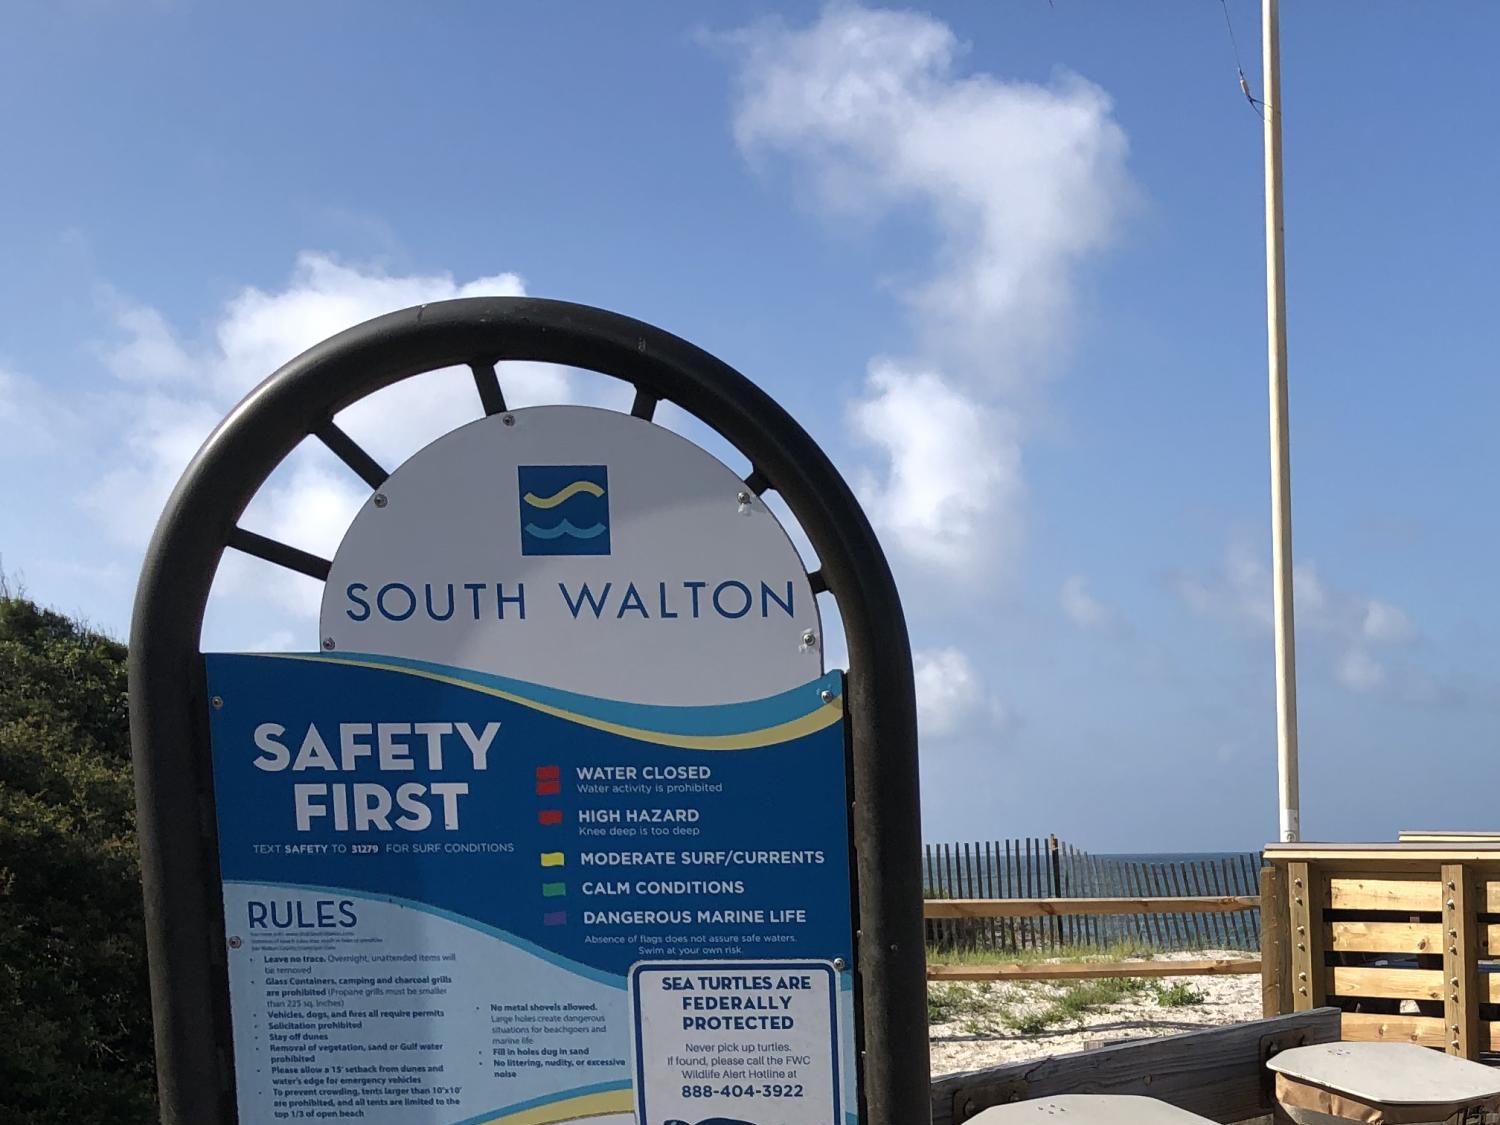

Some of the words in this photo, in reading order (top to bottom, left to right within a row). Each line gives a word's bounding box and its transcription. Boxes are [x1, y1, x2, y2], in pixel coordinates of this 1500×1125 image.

[347, 583, 525, 621] SOUTH
[558, 581, 794, 619] WALTON
[253, 722, 501, 771] SAFETY
[576, 767, 636, 780] WATER
[643, 766, 710, 779] CLOSED
[577, 784, 609, 793] Water
[612, 784, 651, 794] activity
[667, 783, 722, 793] prohibited
[294, 783, 468, 830] FIRST
[579, 810, 620, 822] HIGH
[626, 810, 699, 822] HAZARD
[579, 827, 606, 836] Knee
[610, 827, 636, 836] deep
[673, 826, 700, 836] deep
[253, 845, 280, 854] TEXT
[285, 844, 328, 854] SAFETY
[332, 844, 346, 853] TO
[352, 845, 378, 853] 31279
[386, 844, 408, 852] FOR
[413, 844, 440, 852] SURF
[444, 843, 514, 852] CONDITIONS
[581, 852, 675, 865] MODERATE
[682, 850, 824, 866] SURF/CURRENTS
[582, 882, 630, 894] CALM
[636, 881, 744, 894] CONDITIONS
[248, 900, 357, 928] RULES
[584, 911, 691, 924] DANGEROUS
[698, 910, 764, 923] MARINE
[770, 910, 806, 922] LIFE
[628, 935, 637, 943] of
[640, 935, 662, 944] flags
[742, 934, 760, 942] safe
[638, 946, 664, 954] Swim
[678, 945, 701, 955] your
[662, 977, 694, 990] SEA
[698, 976, 772, 990] TURTLES
[776, 976, 811, 990] ARE
[683, 996, 792, 1010] FEDERALLY
[318, 1021, 362, 1030] prohibited
[683, 1016, 793, 1030] PROTECTED
[269, 1034, 287, 1042] Stay
[686, 1044, 715, 1052] Never
[718, 1043, 739, 1053] pick
[742, 1044, 755, 1053] up
[758, 1042, 791, 1052] turtles.
[668, 1056, 673, 1066] If
[676, 1056, 708, 1066] found,
[711, 1056, 744, 1067] please
[747, 1056, 764, 1065] call
[767, 1056, 783, 1065] the
[786, 1056, 810, 1065] FWC
[682, 1069, 720, 1079] Wildlife
[722, 1070, 746, 1079] Alert
[749, 1070, 785, 1078] Hotline
[788, 1070, 796, 1078] at
[682, 1085, 803, 1098] 888-404-3922
